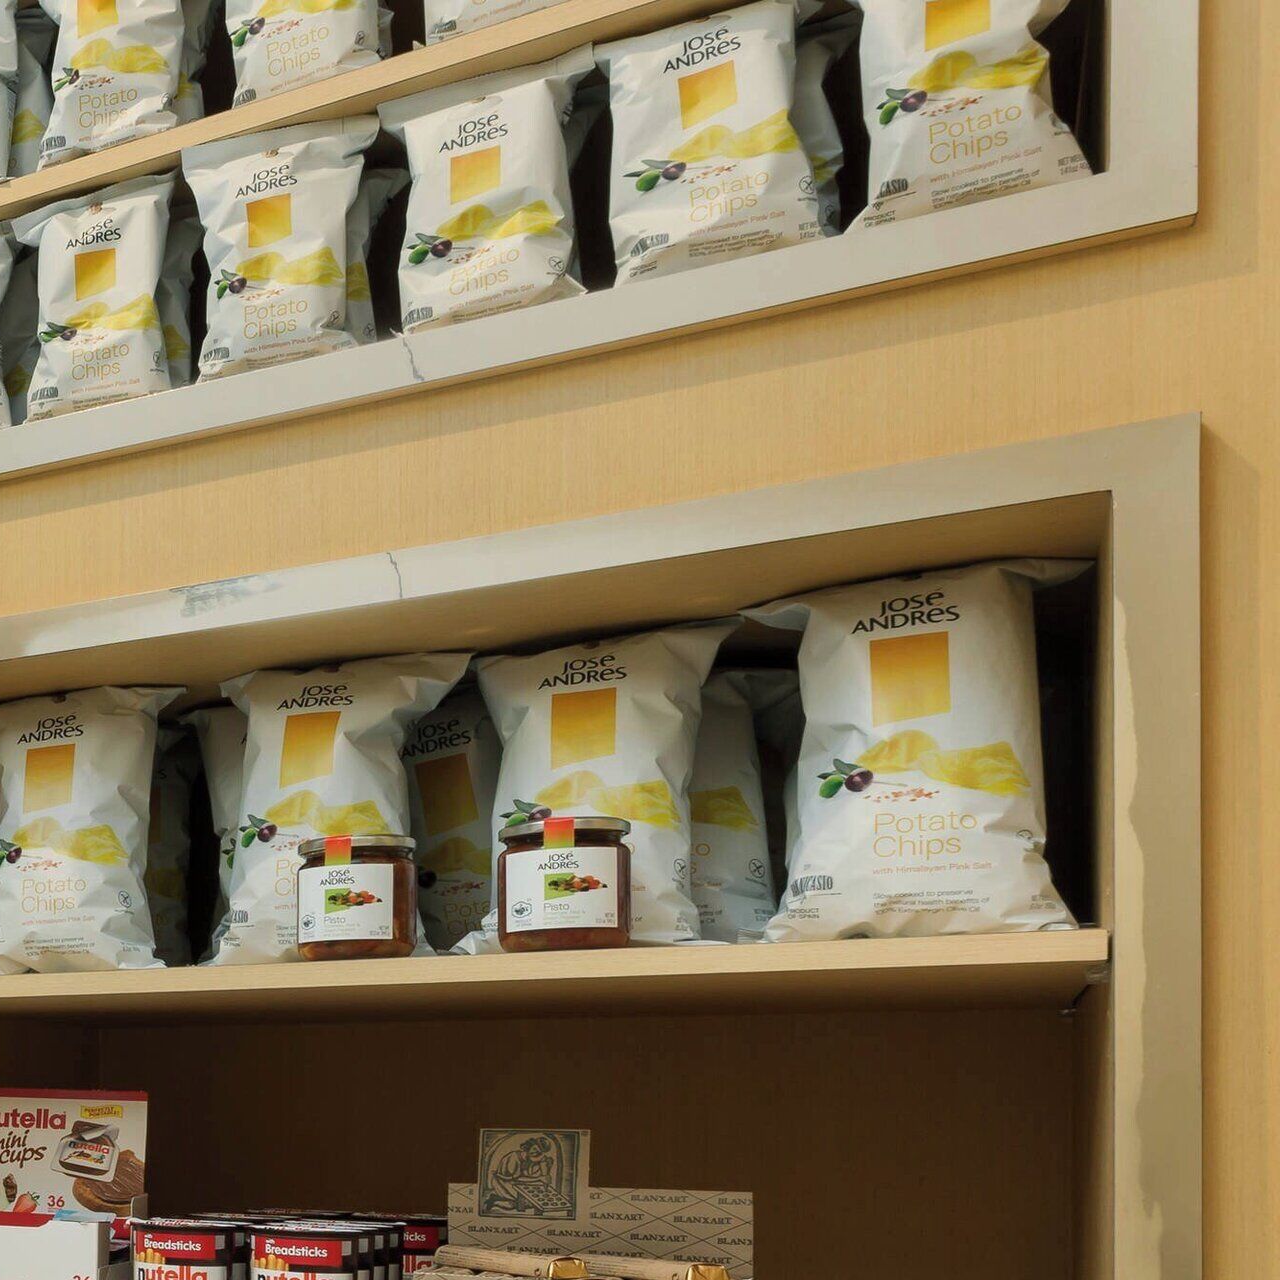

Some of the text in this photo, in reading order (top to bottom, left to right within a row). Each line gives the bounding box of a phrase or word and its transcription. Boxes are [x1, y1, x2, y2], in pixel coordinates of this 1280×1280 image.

[265, 24, 330, 59] Potato
[268, 48, 321, 77] Chips
[79, 87, 138, 111] Potato
[929, 105, 1022, 144] Potato
[930, 130, 1008, 164] Chips
[689, 171, 769, 208] Potato
[689, 193, 758, 223] Chips
[243, 300, 308, 323] Potato
[243, 320, 297, 340] Chips
[71, 342, 129, 365] Potato
[71, 362, 121, 381] Chips
[873, 811, 977, 834] Potato
[873, 835, 961, 860] Chips
[873, 867, 893, 876] with
[22, 877, 87, 896] Potato
[22, 896, 76, 915] Chips
[543, 902, 569, 912] Pisto
[0, 1146, 47, 1168] cups
[47, 1195, 65, 1208] 36
[144, 1239, 201, 1252] Breadsticks
[630, 1233, 688, 1242] BLANXART
[265, 1245, 328, 1258] Breadsticks
